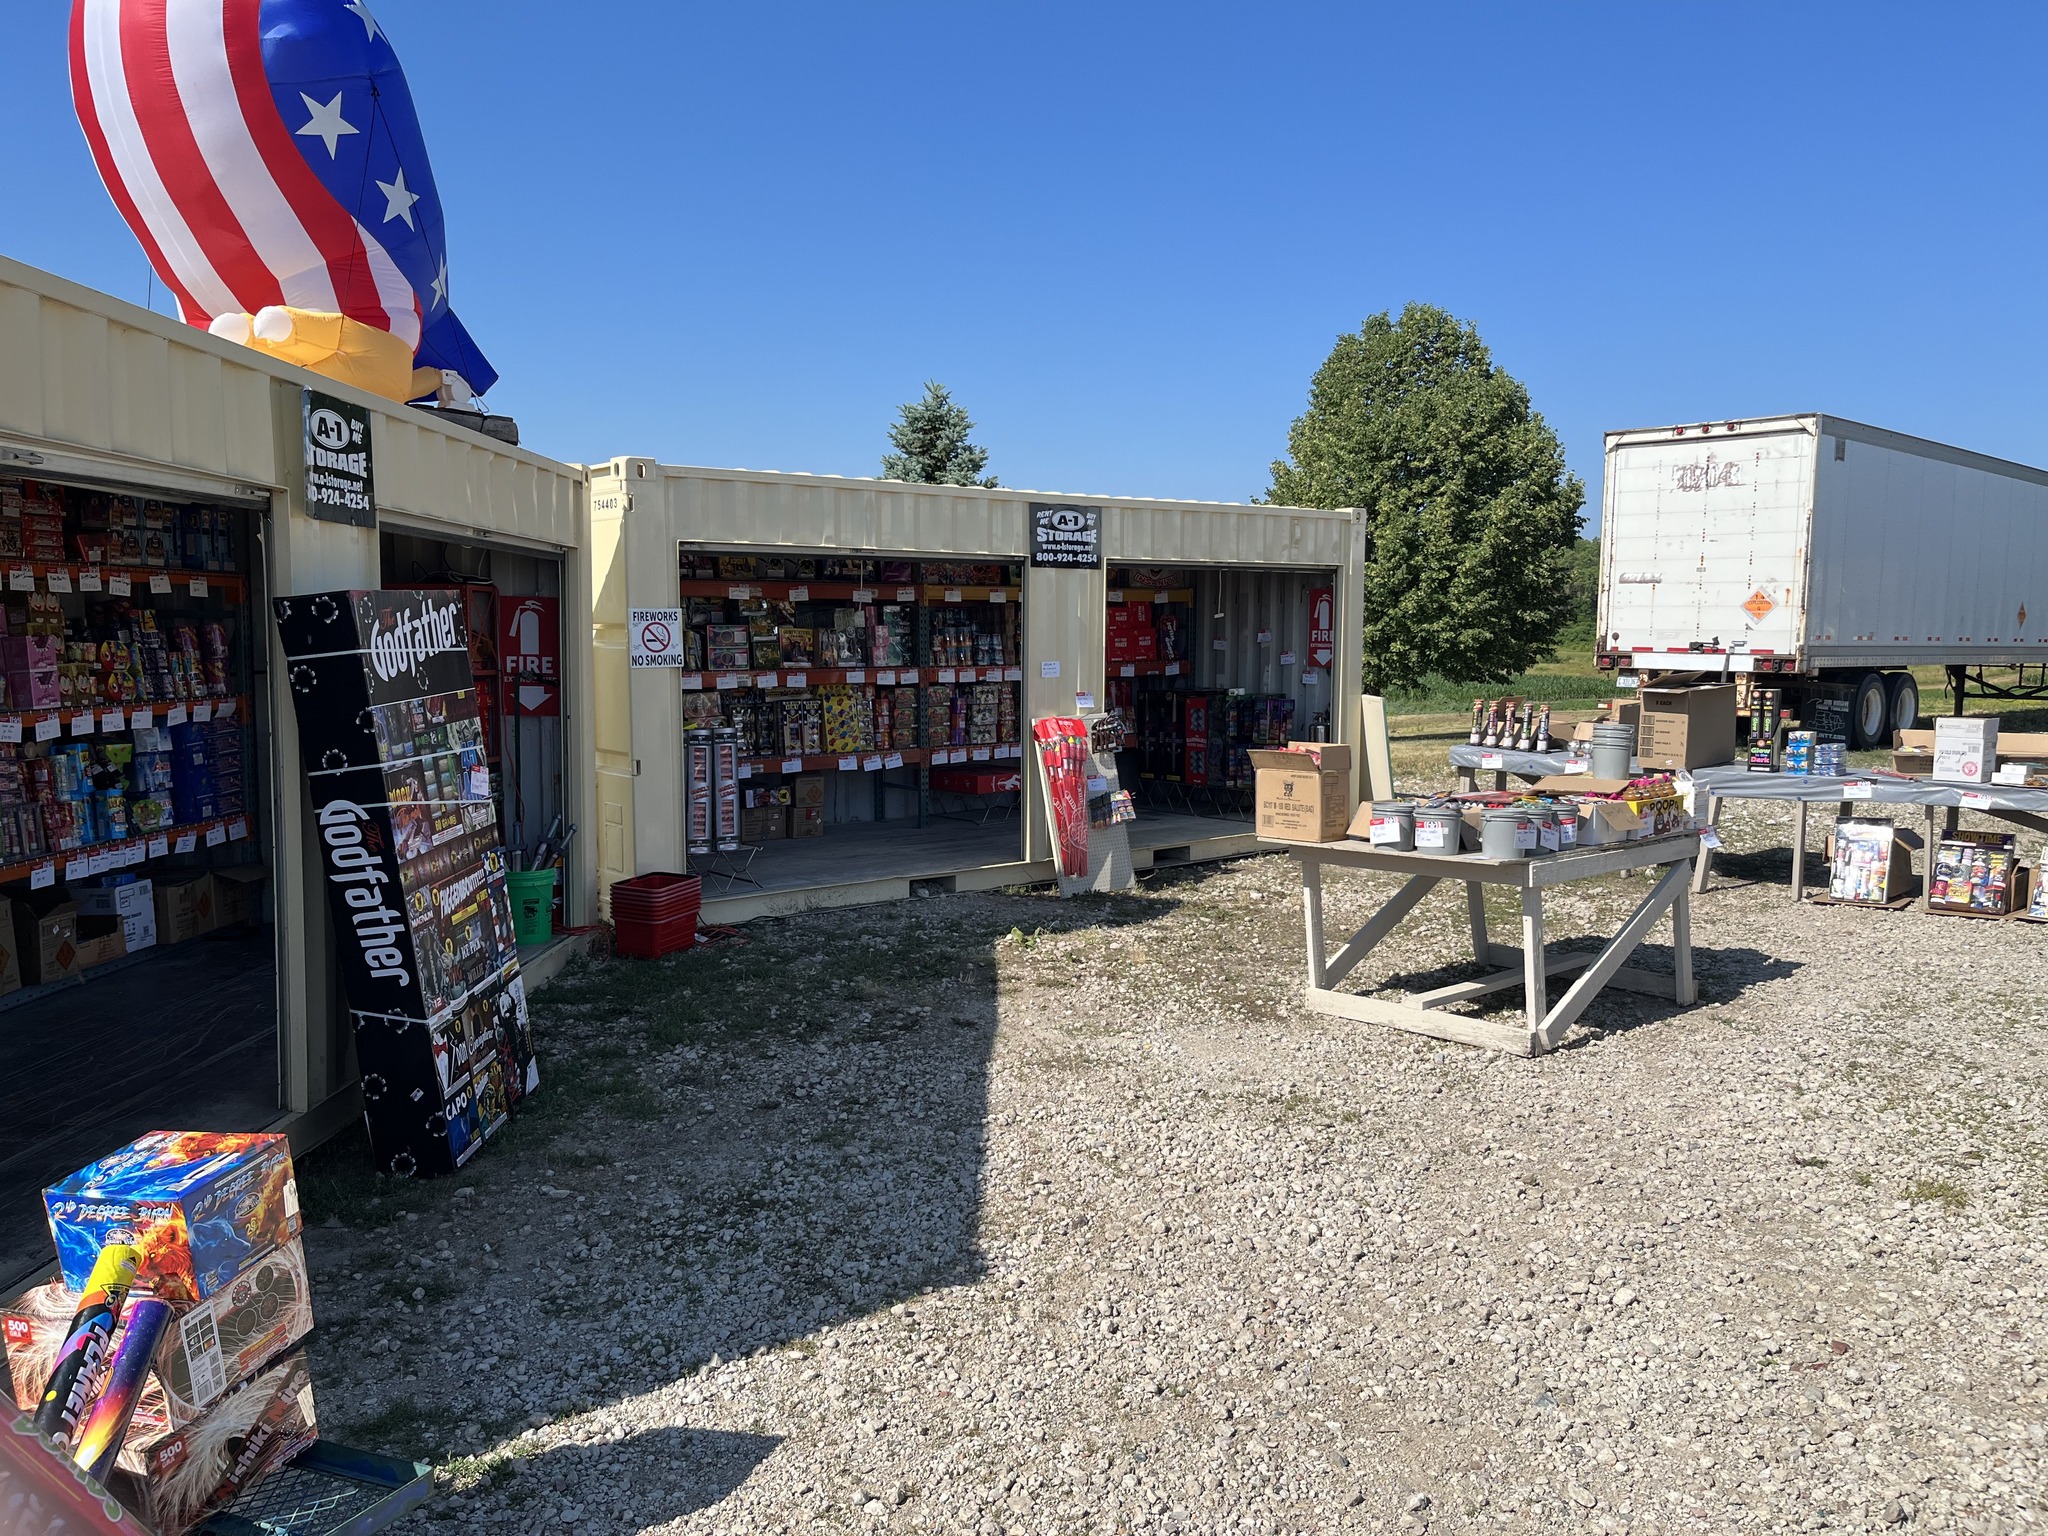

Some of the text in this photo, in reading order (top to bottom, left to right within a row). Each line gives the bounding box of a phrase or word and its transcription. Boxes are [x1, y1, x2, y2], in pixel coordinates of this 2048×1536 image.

[317, 416, 342, 442] A-1
[350, 418, 364, 433] BUY
[351, 431, 363, 445] ME
[593, 497, 618, 511] 754403
[1036, 510, 1053, 519] RENT
[1057, 515, 1079, 527] A-1
[1036, 526, 1097, 544] STORAGE
[1036, 552, 1098, 563] 800-924-4254
[632, 611, 679, 622] FIREWORKS
[370, 598, 457, 683] Godfather
[506, 656, 553, 674] FIRE
[631, 653, 683, 667] NO SMOKING
[1750, 747, 1771, 755] Glow
[1750, 756, 1770, 764] Dark
[1951, 831, 2003, 844] SHOWTIME
[319, 799, 410, 987] Godfather
[411, 909, 434, 927] MAGNUM
[446, 1091, 468, 1121] CAPO
[214, 1171, 256, 1200] DEGREE
[78, 1204, 132, 1223] DEGREE
[137, 1205, 174, 1222] BURN
[8, 1319, 29, 1332] 500
[213, 1369, 309, 1500] Nishiki Mine
[159, 1440, 182, 1462] 500
